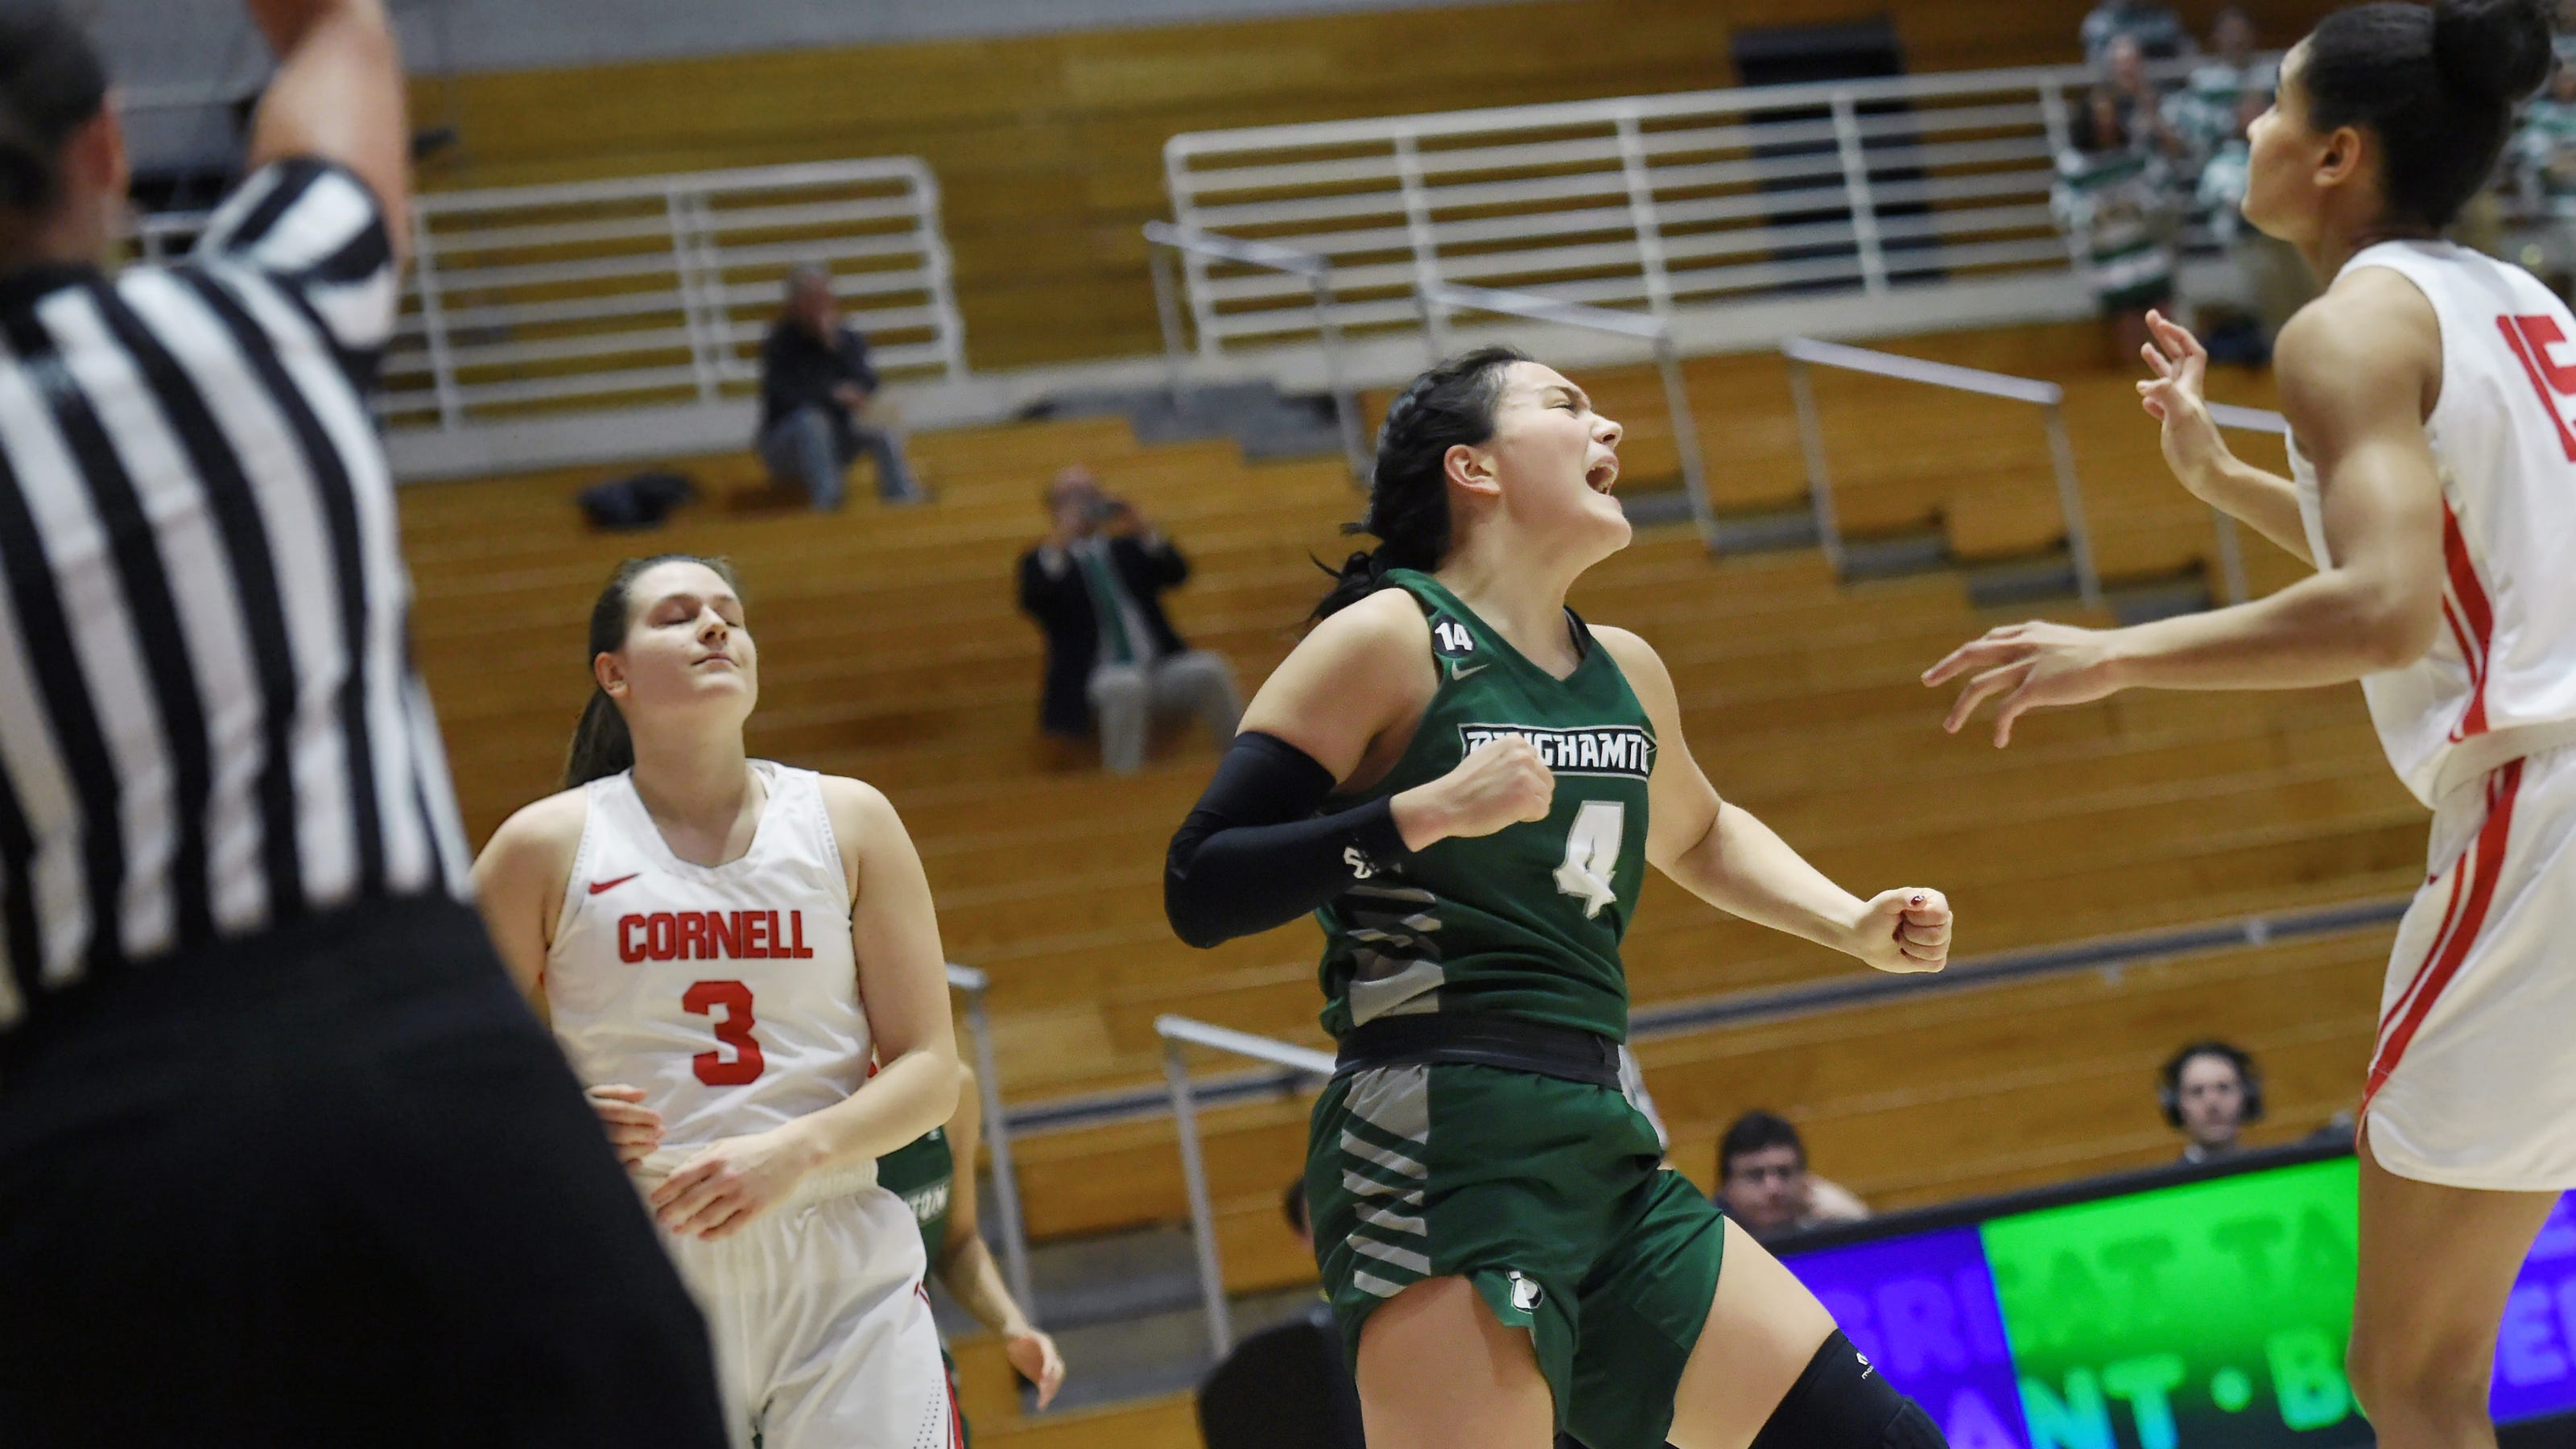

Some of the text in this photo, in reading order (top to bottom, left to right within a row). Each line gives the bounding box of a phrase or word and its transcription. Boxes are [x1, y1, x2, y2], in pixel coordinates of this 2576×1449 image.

[1434, 621, 1474, 652] 14
[1467, 730, 1649, 775] BGHAMTO
[1552, 799, 1624, 920] 4
[618, 910, 814, 964] CORNELL
[682, 980, 765, 1086] 3
